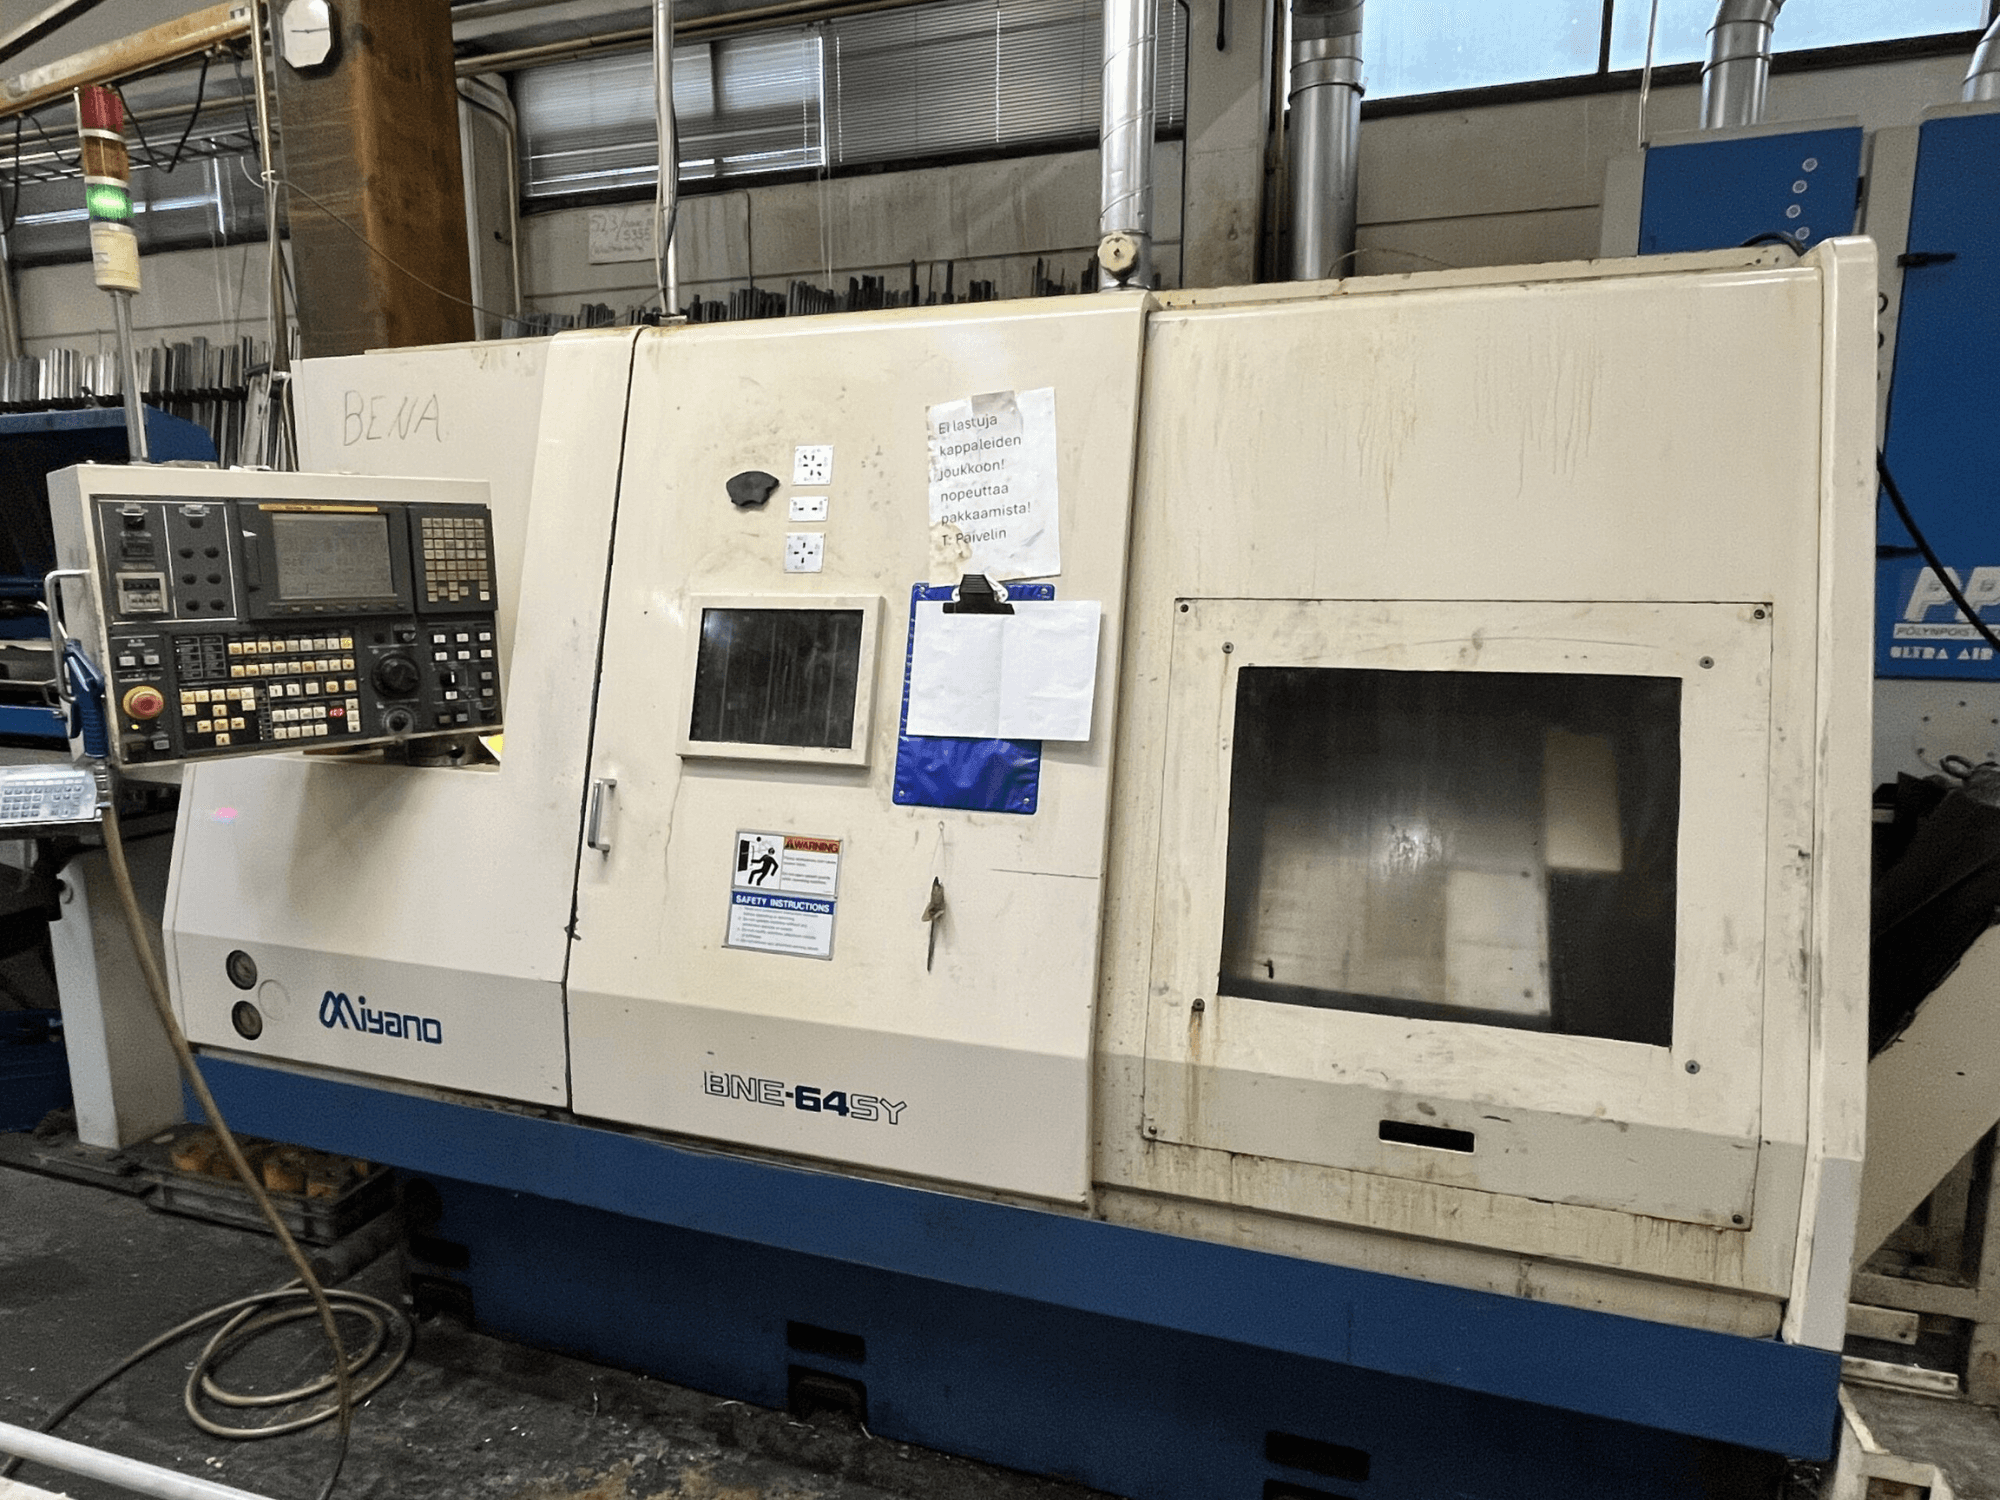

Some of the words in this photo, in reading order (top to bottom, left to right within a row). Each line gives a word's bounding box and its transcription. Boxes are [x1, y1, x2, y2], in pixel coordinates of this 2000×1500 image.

[343, 389, 442, 446] BENA
[953, 413, 997, 432] lastuja
[939, 435, 1021, 457] kappaleiden
[938, 459, 1005, 481] joukkoon!
[940, 484, 1009, 502] nopeuttaa
[941, 501, 1031, 526] pakkaamista!
[794, 838, 839, 853] WARNING
[735, 894, 767, 906] SAFETY
[770, 899, 830, 913] INSTRUCTIONS
[319, 990, 442, 1045] Miyano
[703, 1070, 908, 1125] BNE-64SY
